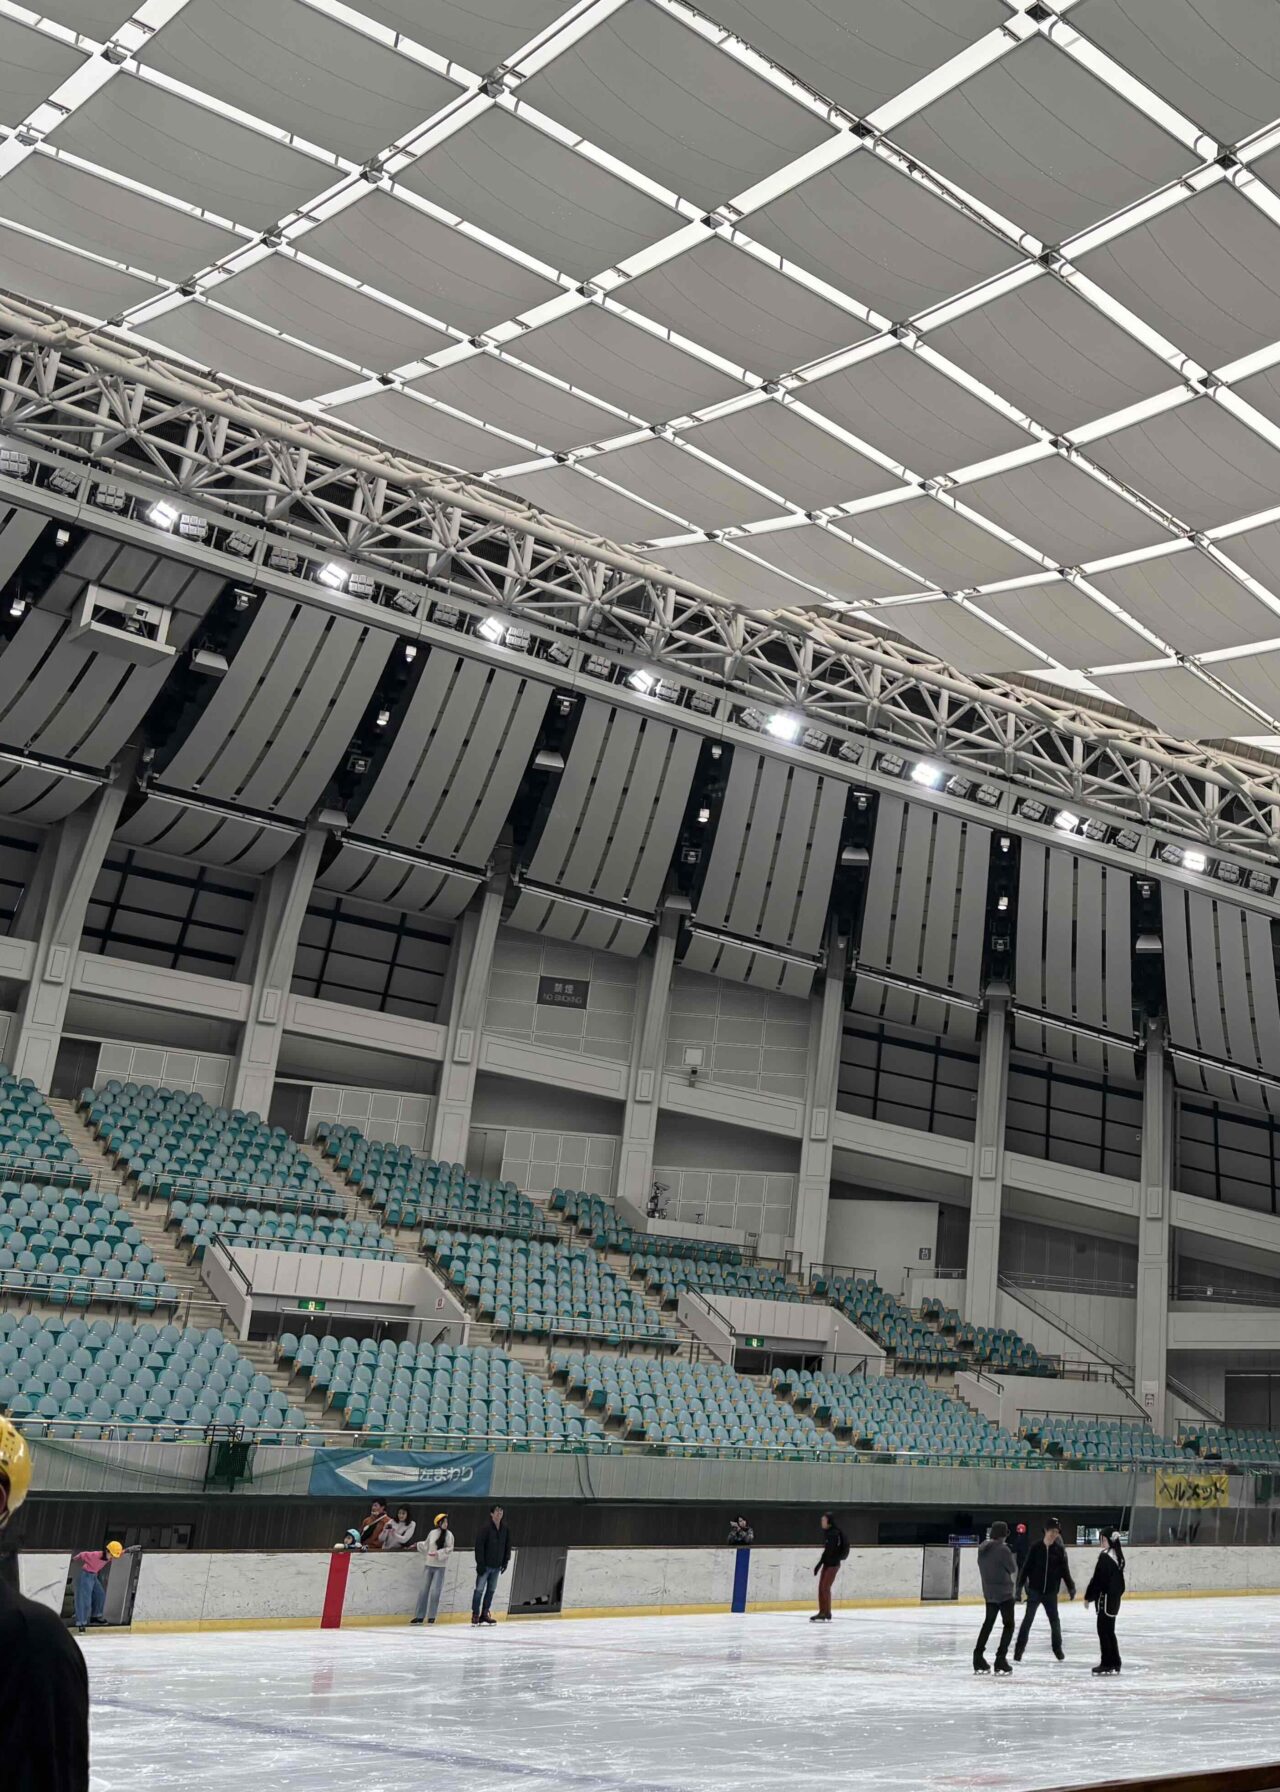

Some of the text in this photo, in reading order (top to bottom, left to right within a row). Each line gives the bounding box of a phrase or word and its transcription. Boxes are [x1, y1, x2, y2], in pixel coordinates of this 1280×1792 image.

[419, 1466, 474, 1482] 左まわり
[1159, 1481, 1225, 1502] ヘルメット
